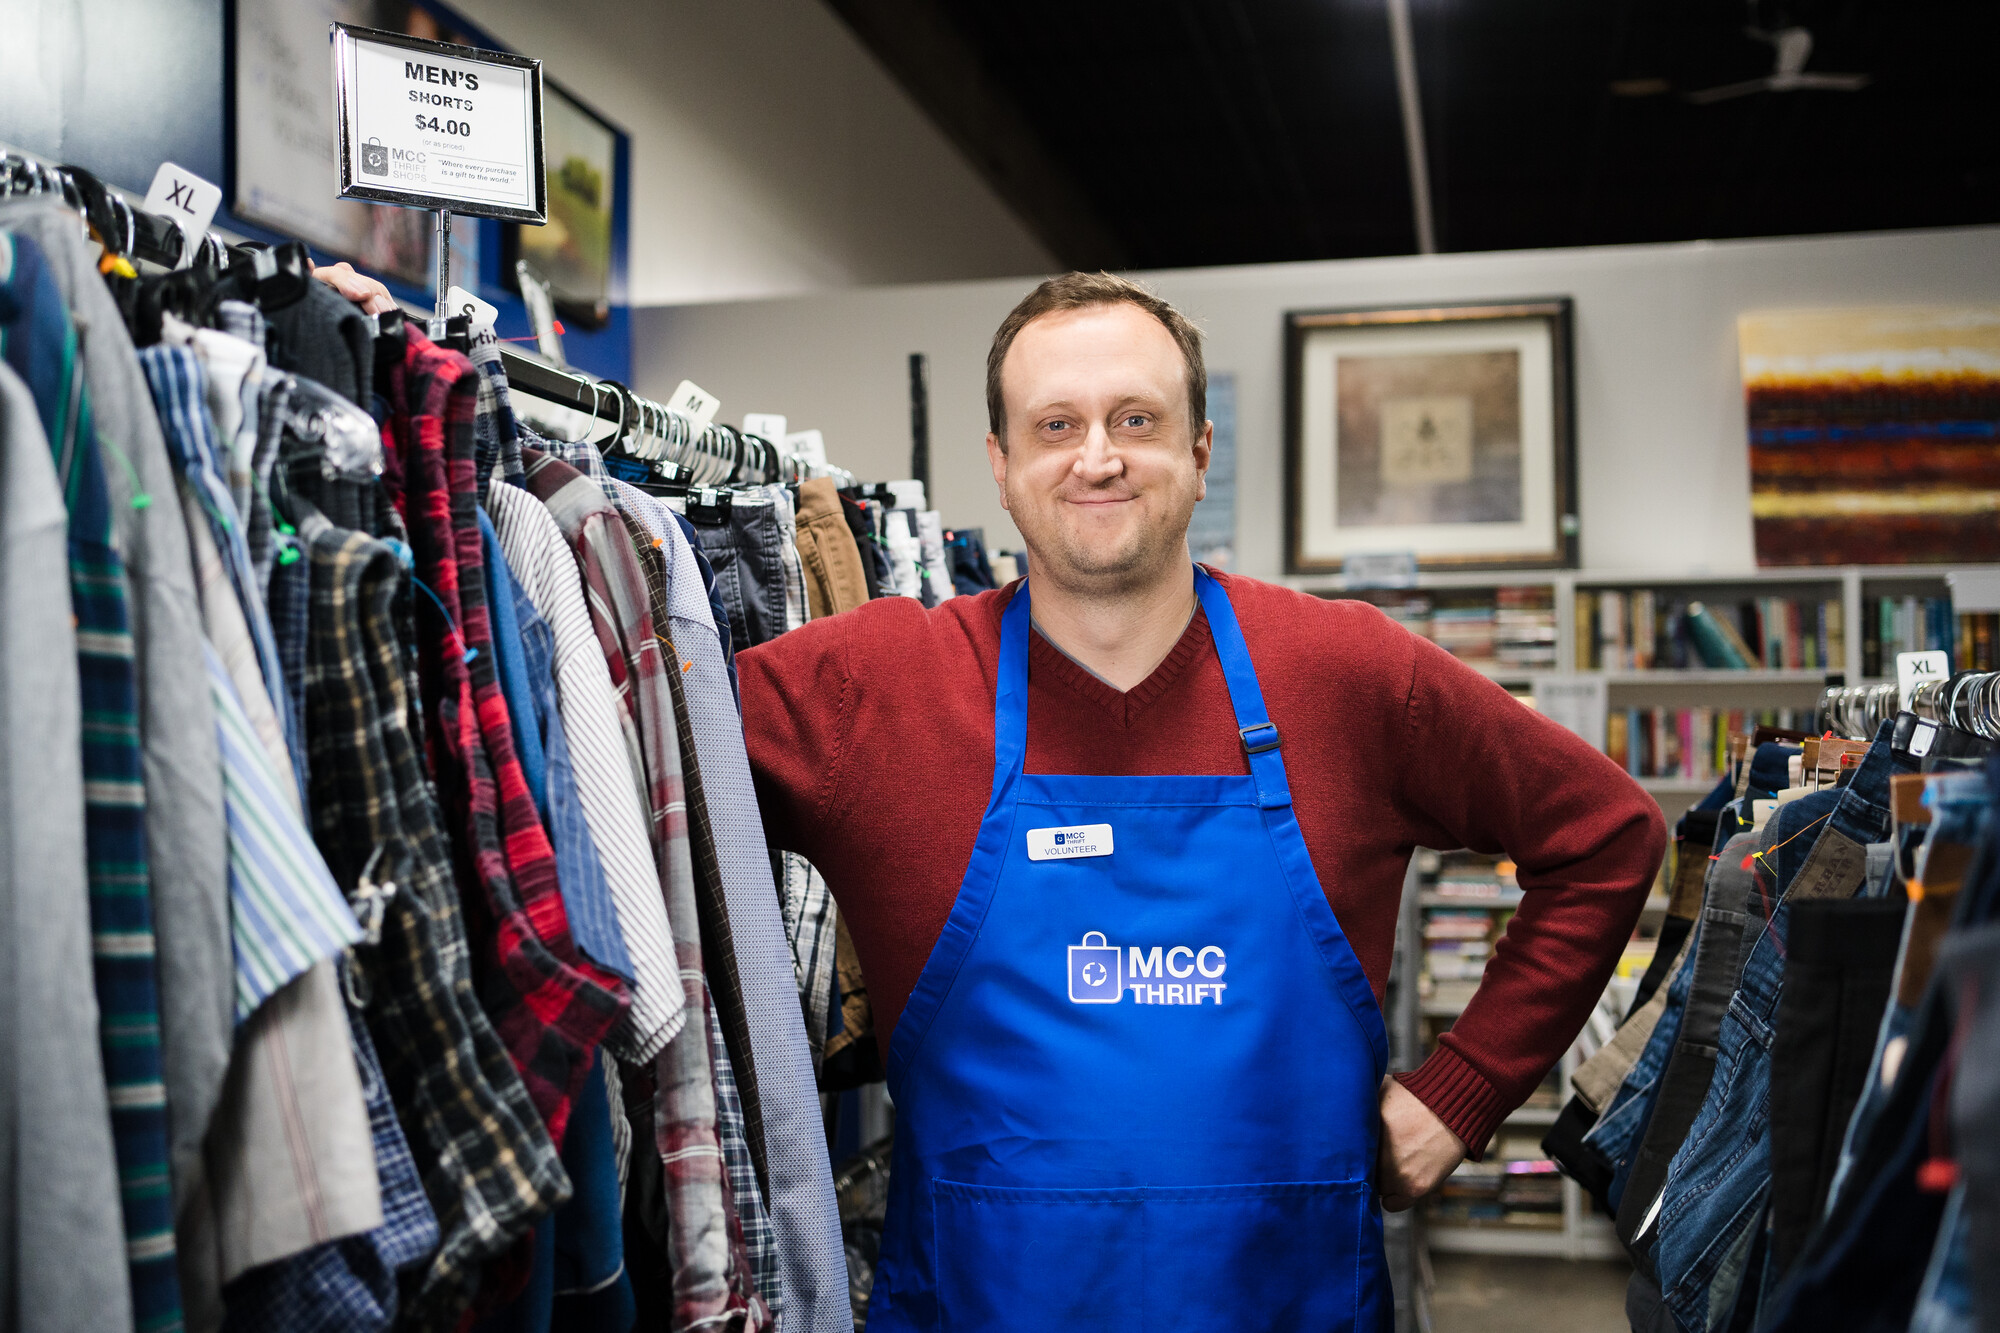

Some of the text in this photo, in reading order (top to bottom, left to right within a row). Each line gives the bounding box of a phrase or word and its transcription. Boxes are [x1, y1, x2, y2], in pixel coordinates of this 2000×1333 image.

[405, 61, 479, 91] MEN’S
[408, 90, 474, 111] SHORTS
[415, 113, 471, 137] $4.00
[443, 142, 466, 152] priced)
[392, 148, 427, 164] MCC
[394, 161, 427, 173] THRIFT
[465, 164, 484, 172] every
[485, 166, 517, 176] purchase
[393, 170, 427, 182] SHOPS
[165, 178, 197, 215] XL
[686, 395, 703, 413] M
[761, 421, 770, 435] L
[1911, 660, 1937, 675] XL
[1044, 844, 1098, 856] VOLUNTEER
[1129, 945, 1226, 979] MCC
[1129, 983, 1227, 1004] THRIFT
